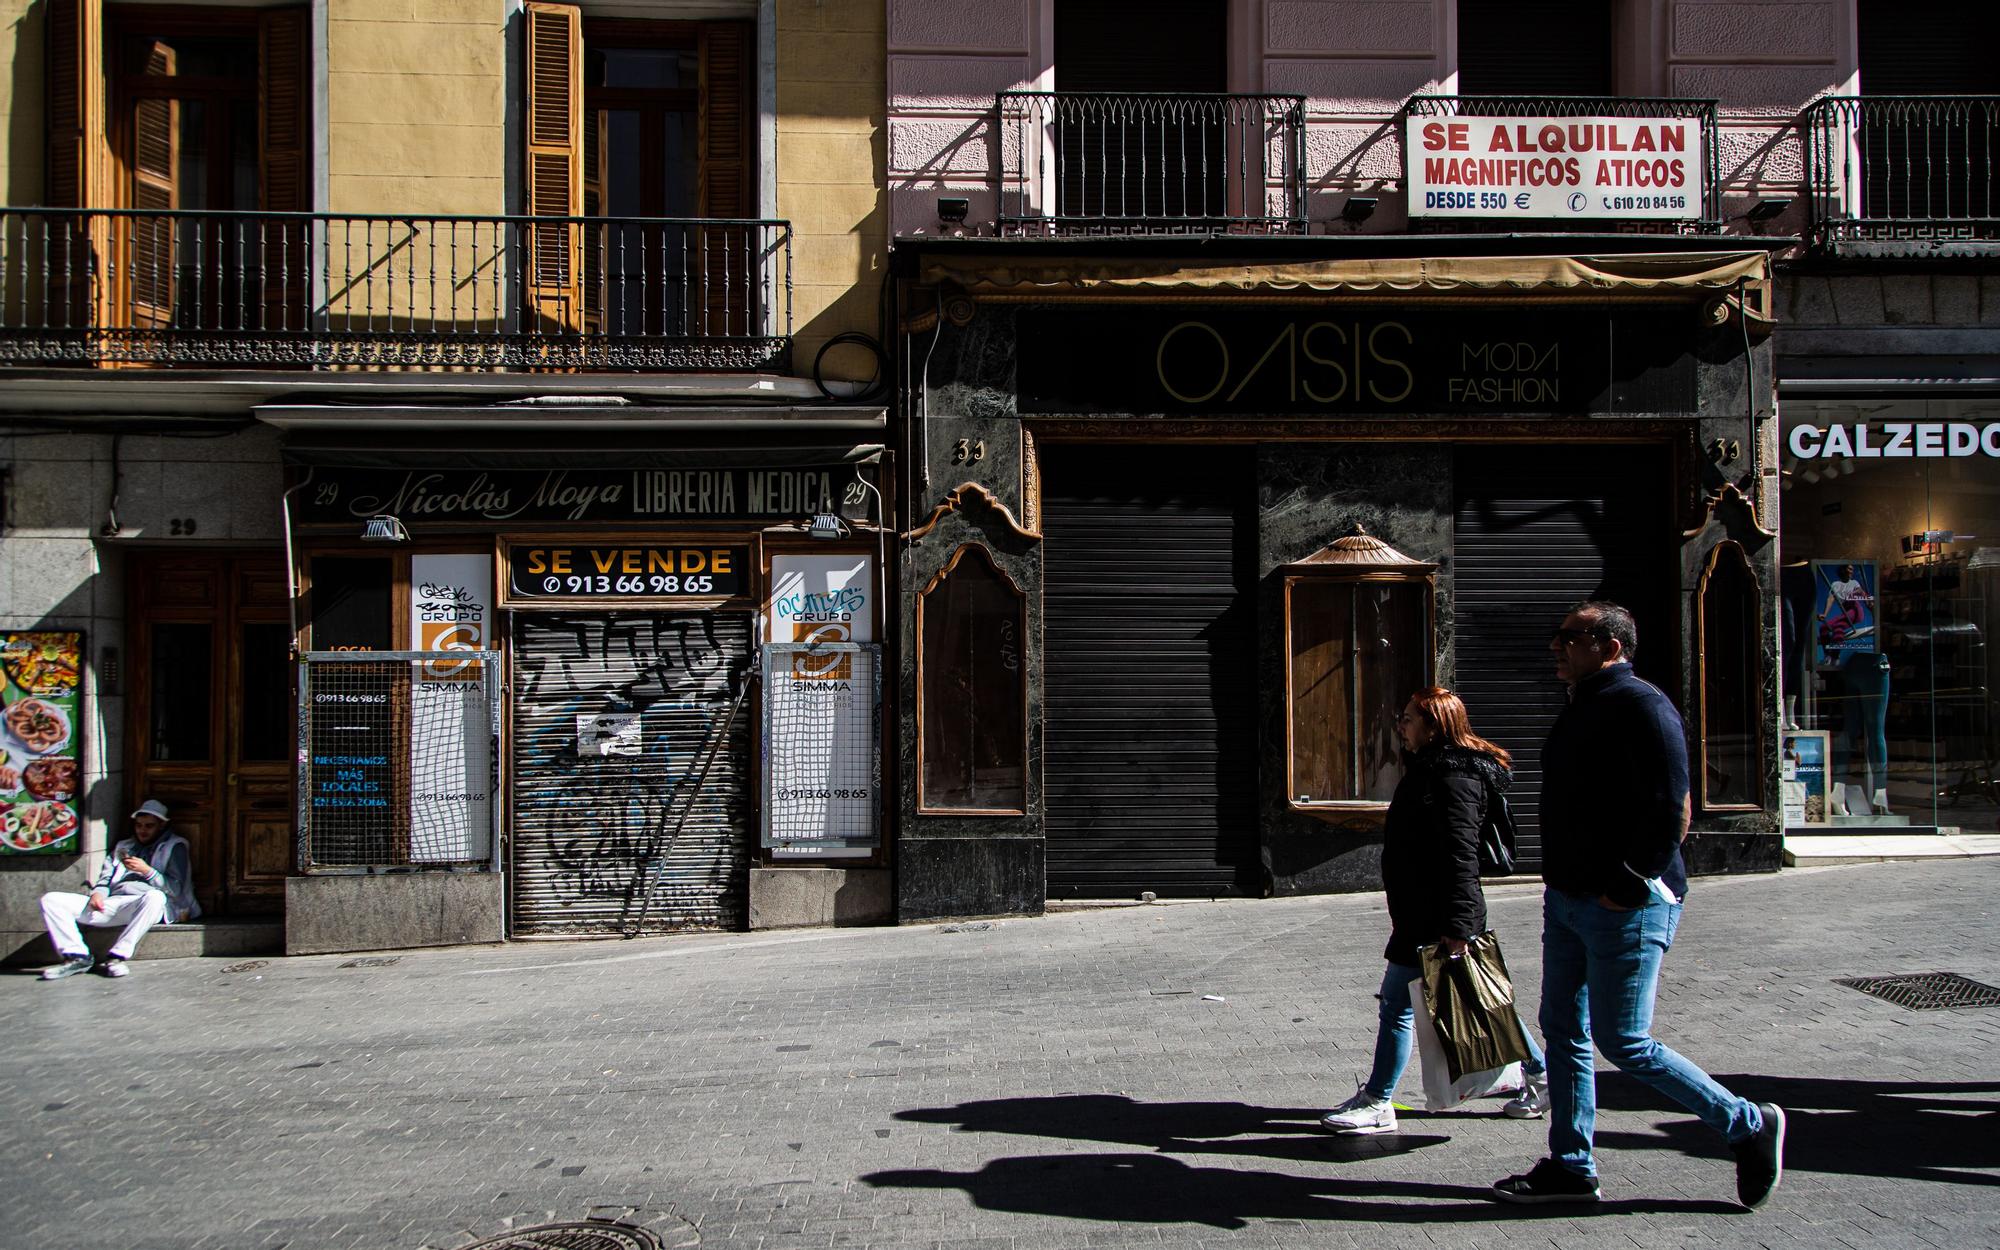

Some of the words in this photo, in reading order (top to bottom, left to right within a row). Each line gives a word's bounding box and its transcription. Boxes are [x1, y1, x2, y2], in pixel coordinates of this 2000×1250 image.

[1422, 122, 1470, 152] SE
[1488, 124, 1686, 153] ALQUILAN
[1424, 157, 1581, 187] MAGNIFICOS
[1595, 158, 1686, 188] ATICOS
[1425, 191, 1476, 209] DESDE
[1480, 192, 1507, 210] 550
[1613, 196, 1634, 210] 610
[1636, 196, 1650, 210] 20
[1653, 196, 1668, 209] 84
[1670, 195, 1685, 209] 56
[1156, 320, 1414, 403] OASIS
[1462, 341, 1560, 373] MODA
[1448, 378, 1560, 403] FASHION
[957, 438, 985, 460] 31
[314, 482, 339, 505] 29
[350, 471, 512, 518] Nicolás
[483, 468, 624, 521] Moya
[633, 471, 736, 514] LIBRERIA
[748, 471, 833, 515] MEDICA
[843, 482, 867, 505] 29
[170, 518, 197, 536] 29
[528, 550, 573, 575] SE
[592, 550, 732, 574] VENDE
[567, 576, 611, 593] 913
[615, 576, 645, 593] 66
[649, 576, 679, 593] 98
[684, 576, 713, 593] 65
[421, 613, 482, 622] GRUPO
[792, 612, 852, 622] GRUPO
[421, 682, 482, 693] SIMMA
[793, 682, 852, 692] SIMMA
[326, 694, 345, 703] 913
[790, 789, 814, 799] 913
[816, 789, 832, 799] 66
[834, 789, 850, 799] 98
[852, 789, 868, 799] 65
